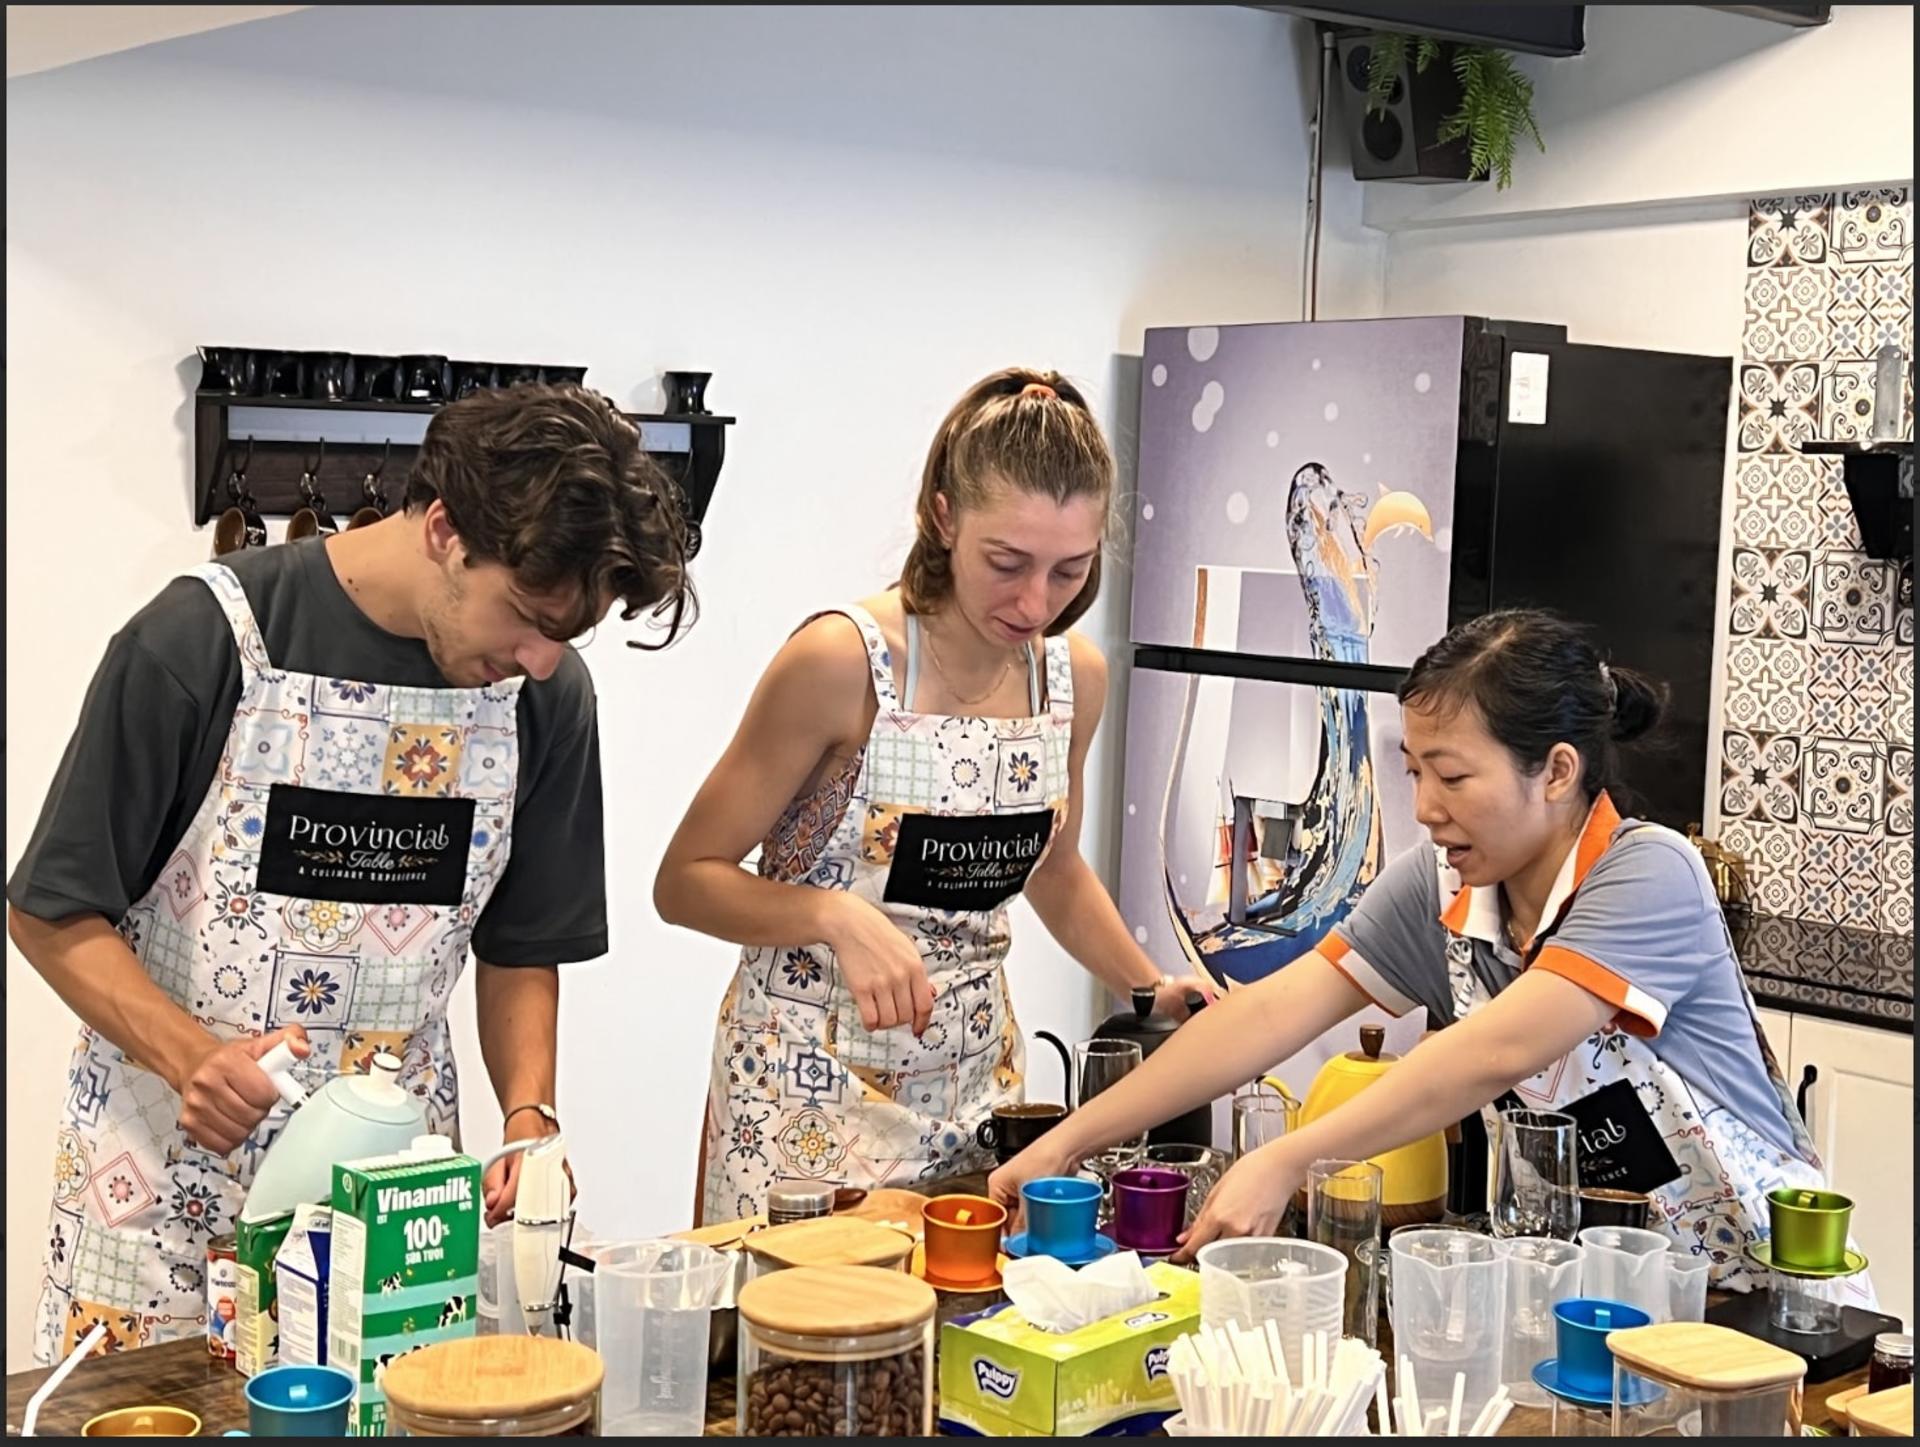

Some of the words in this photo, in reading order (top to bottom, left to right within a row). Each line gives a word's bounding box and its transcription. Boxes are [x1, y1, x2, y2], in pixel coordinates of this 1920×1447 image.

[289, 815, 449, 850] Provincial
[922, 832, 1041, 862] Provincial
[311, 868, 363, 880] CULINARY
[346, 850, 395, 870] Table
[965, 862, 1002, 879] Table
[377, 1176, 472, 1213] Vinamilk
[978, 1362, 1015, 1392] Pulppy
